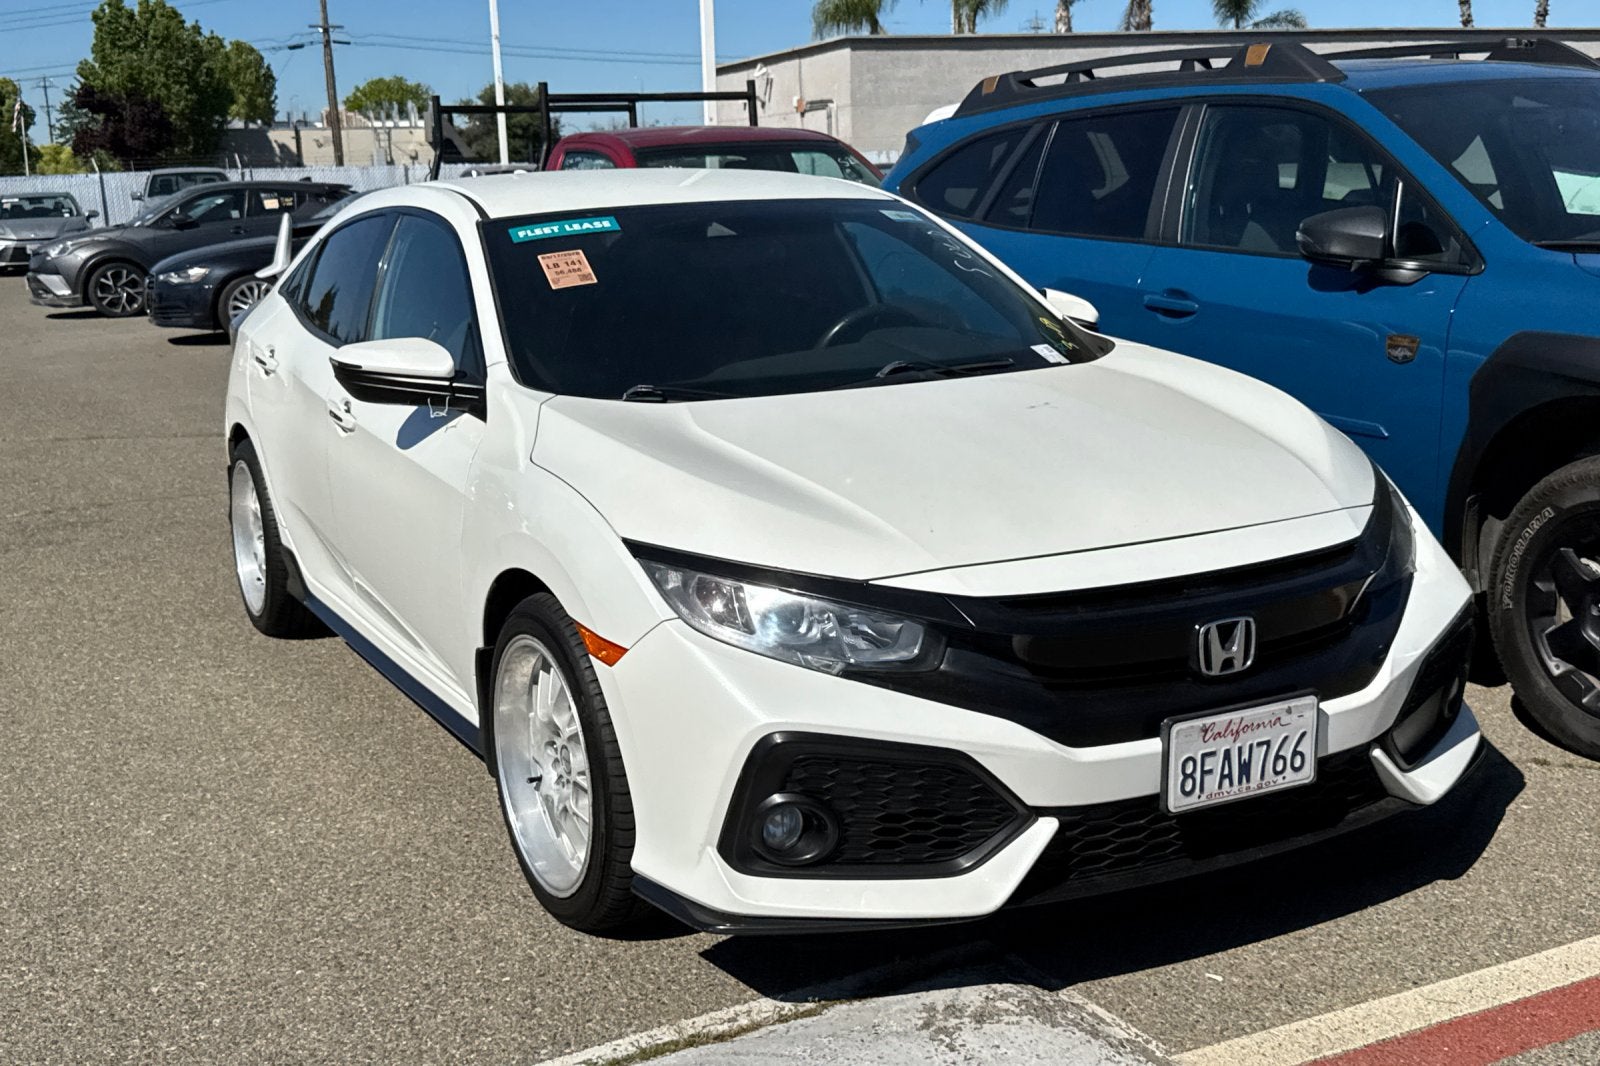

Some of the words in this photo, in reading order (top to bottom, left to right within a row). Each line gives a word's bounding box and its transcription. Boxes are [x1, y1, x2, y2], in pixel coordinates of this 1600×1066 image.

[517, 225, 559, 238] FLEET
[564, 220, 611, 231] LEASE
[546, 262, 561, 270] LB
[564, 259, 583, 268] 141
[1502, 506, 1555, 609] YOKOHAMA
[1202, 715, 1291, 744] California
[1179, 730, 1308, 797] 8FAW766
[1205, 777, 1279, 800] dmv.ca.gov
